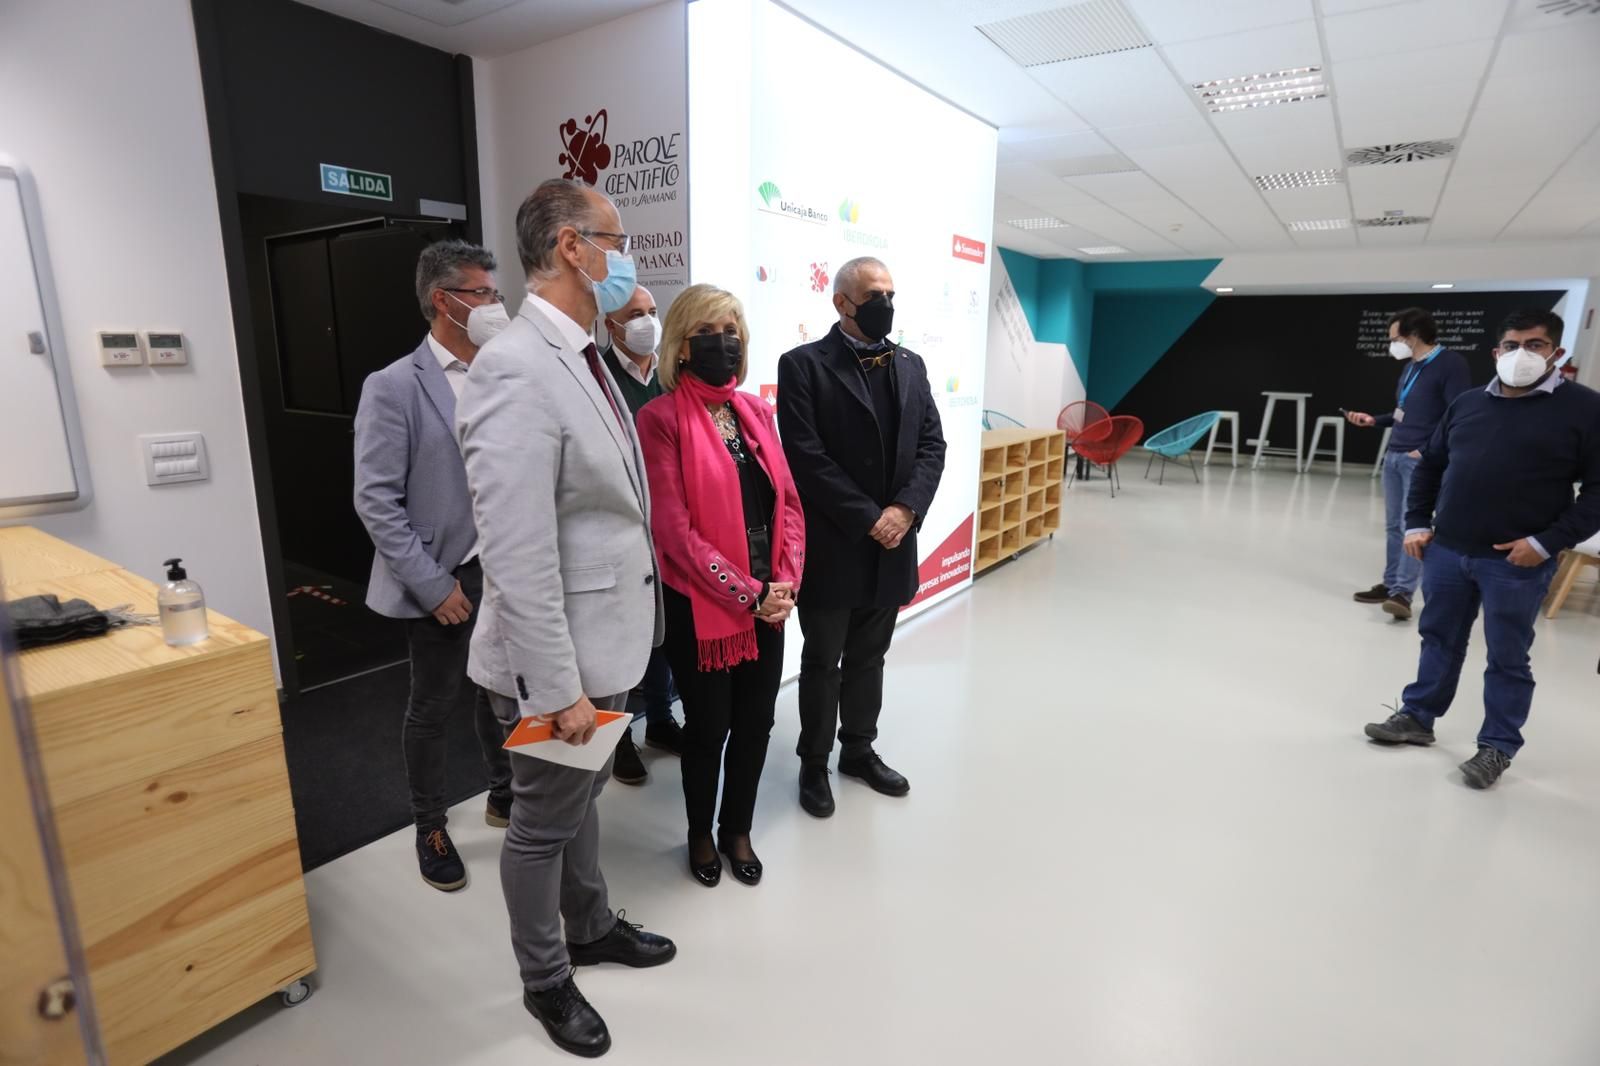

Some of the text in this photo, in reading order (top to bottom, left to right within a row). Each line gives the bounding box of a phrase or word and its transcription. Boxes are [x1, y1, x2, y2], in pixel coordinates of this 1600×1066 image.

[328, 171, 386, 194] SALIDA
[808, 208, 828, 222] Banco
[630, 231, 683, 251] ERSIDAD
[637, 252, 684, 270] MANCA
[941, 546, 971, 568] impulsando
[939, 563, 970, 583] innovadoras
